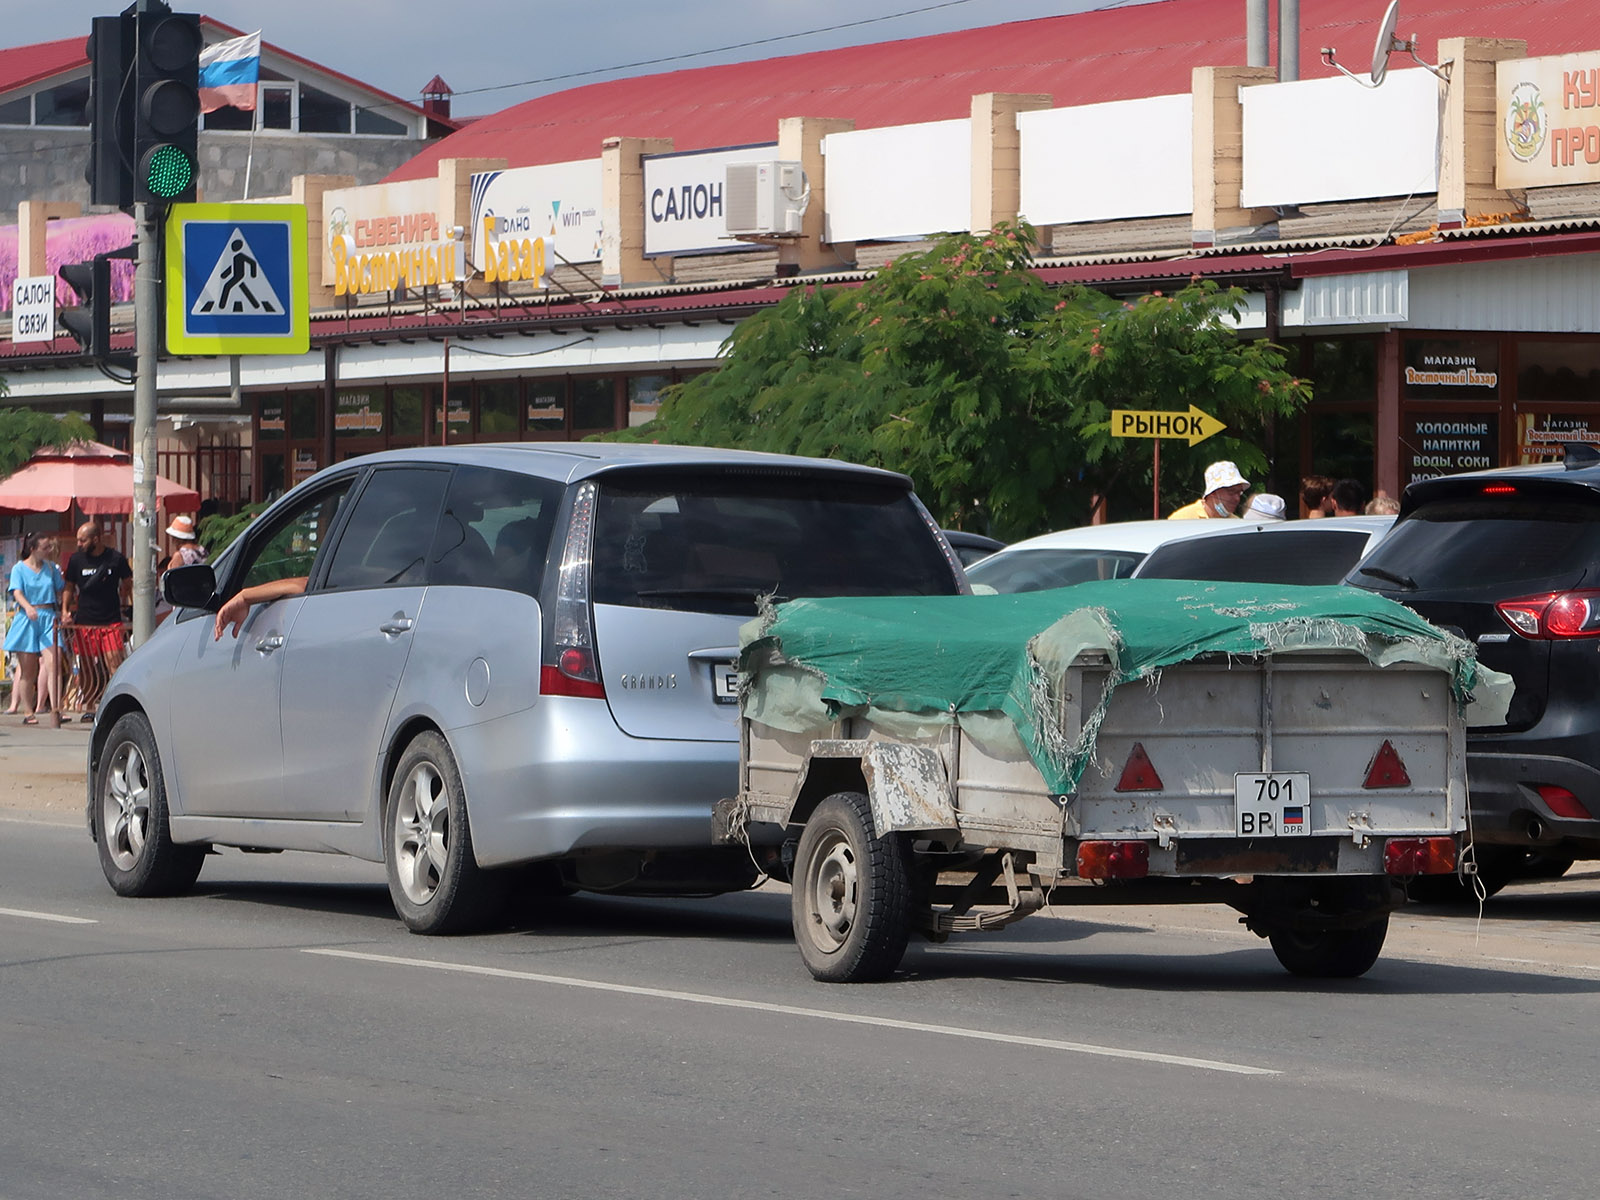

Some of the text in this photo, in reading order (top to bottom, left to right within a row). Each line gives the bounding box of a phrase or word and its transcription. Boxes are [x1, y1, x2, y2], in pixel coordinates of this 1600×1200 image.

[1563, 67, 1600, 110] КУ
[651, 181, 723, 223] САЛОН
[562, 206, 581, 227] win
[332, 217, 555, 296] Восточный Базар
[16, 283, 51, 305] САЛОН
[18, 313, 48, 335] СВЯЗИ
[1424, 356, 1476, 365] МАГАЗИН
[1406, 367, 1497, 388] Восточный Базар
[1122, 414, 1203, 435] РЫНОК
[1415, 422, 1488, 435] ХОЛОДНЫЕ
[1543, 420, 1588, 428] МАГАЗИН
[1423, 440, 1480, 451] НАПИТКИ
[1526, 428, 1600, 444] Восточный База
[1413, 456, 1490, 468] ВОДЫ, СОКИ
[620, 673, 677, 690] GRANDIS
[1254, 779, 1293, 801] 701
[1241, 812, 1272, 834] BP
[1283, 825, 1303, 834] DPR
